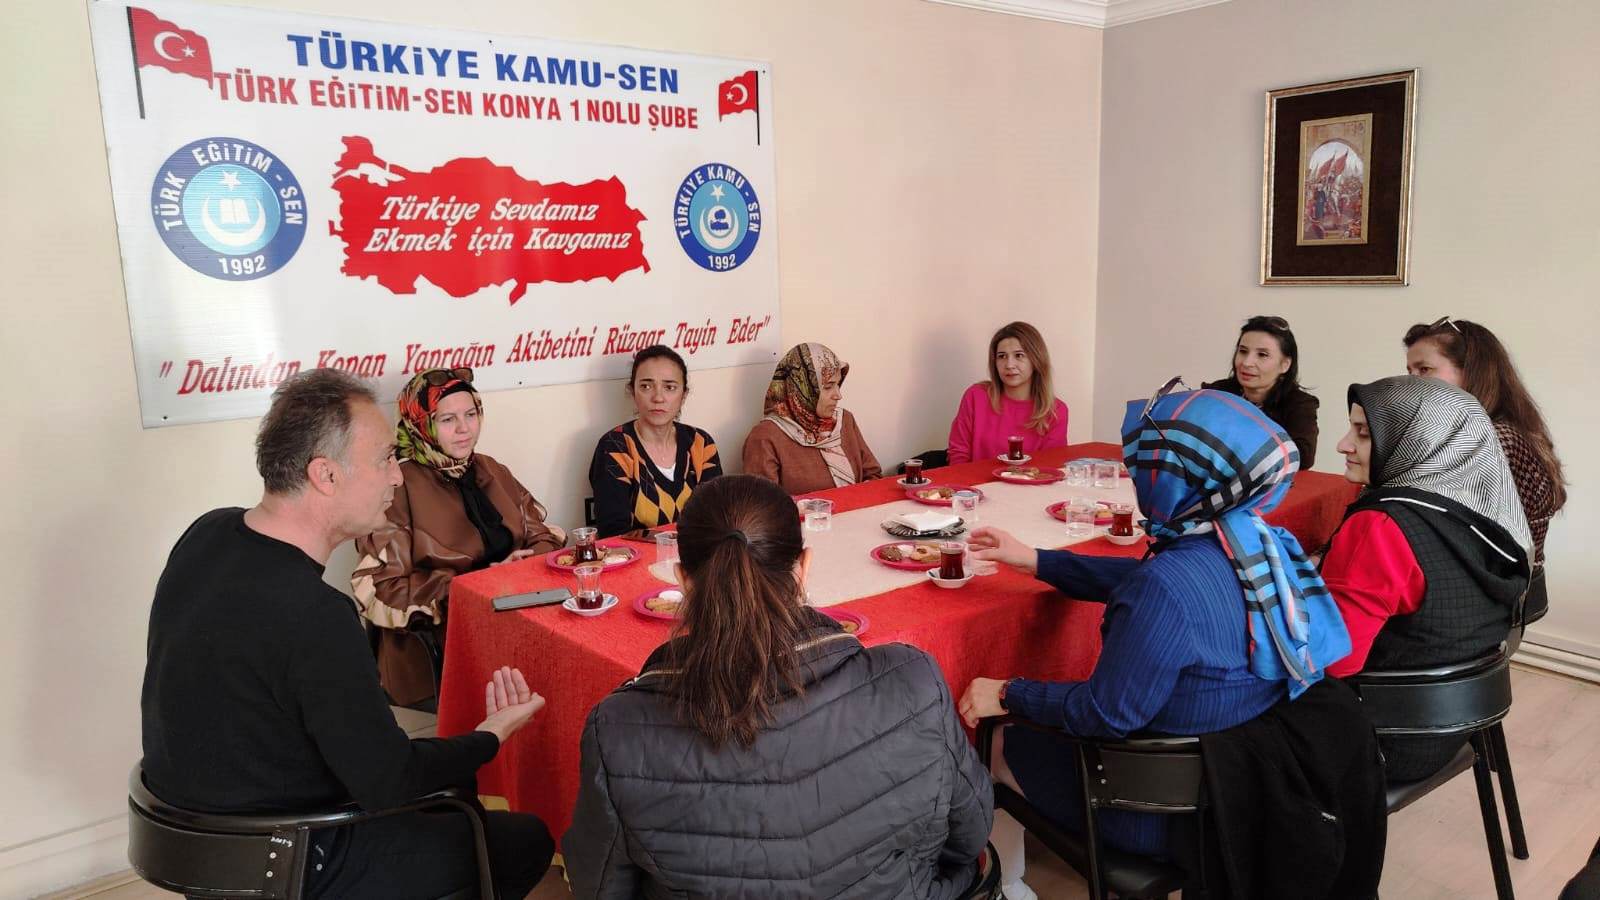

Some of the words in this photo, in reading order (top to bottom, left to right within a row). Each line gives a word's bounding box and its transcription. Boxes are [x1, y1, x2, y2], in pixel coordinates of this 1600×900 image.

[495, 53, 679, 94] KAMU-SEN
[214, 68, 298, 105] TÜRK
[482, 92, 561, 121] KONYA
[570, 101, 580, 122] 1
[587, 101, 640, 126] NOLU
[648, 104, 698, 131] ŞUBE
[154, 171, 186, 231] TÜRK
[280, 185, 303, 225] SEN
[379, 196, 481, 226] Türkiye
[490, 198, 600, 221] Sevdamız
[707, 165, 745, 189] KAMU
[748, 202, 760, 233] SEN
[363, 227, 457, 252] Ekmek
[467, 226, 513, 256] için
[523, 227, 632, 255] Kavgamız
[708, 253, 737, 270] 1992
[218, 254, 267, 276] 1992
[506, 326, 598, 363] Akibetini
[673, 318, 717, 354] Tayin
